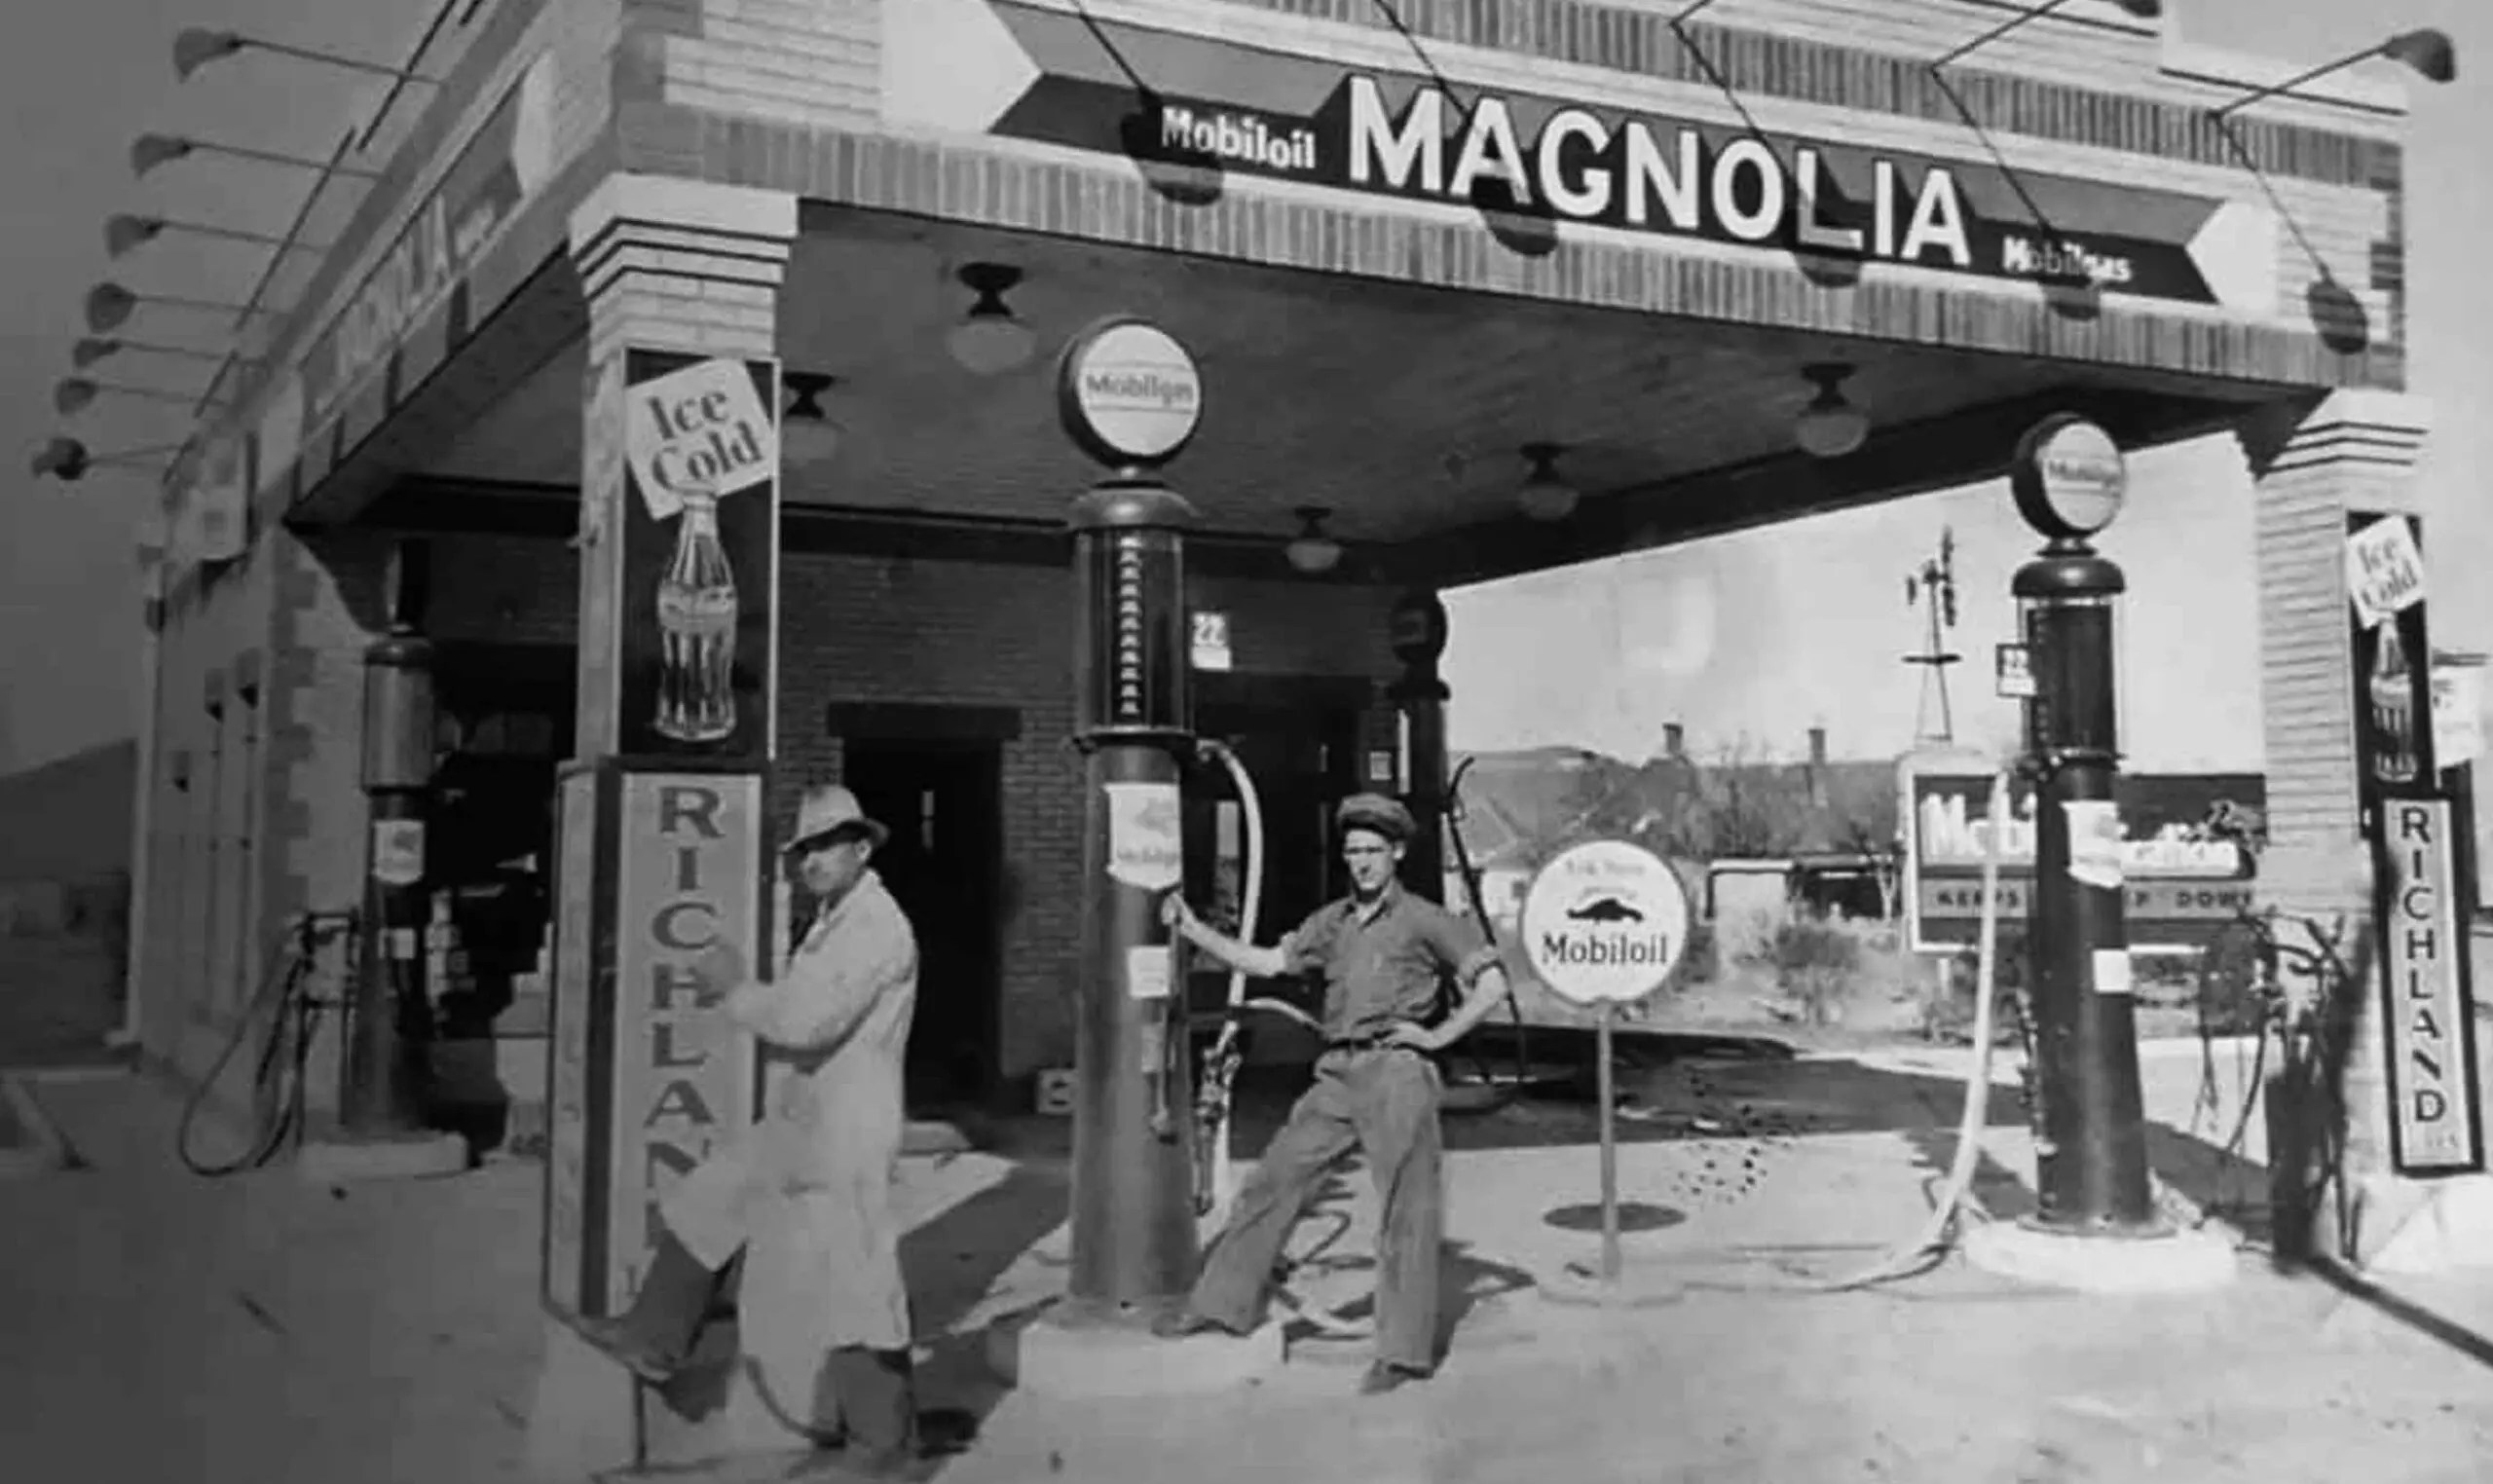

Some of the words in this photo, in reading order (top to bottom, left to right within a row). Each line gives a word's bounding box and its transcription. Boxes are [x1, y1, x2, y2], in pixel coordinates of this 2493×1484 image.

[1162, 106, 1316, 169] Mobiloil
[1350, 76, 1971, 265] MAGNOLIA
[648, 390, 730, 440] Ice
[651, 420, 764, 490] Cold
[1542, 931, 1668, 965] Mobiloil
[2400, 806, 2447, 1123] RICHLAND
[643, 786, 726, 1249] RICHLAN
